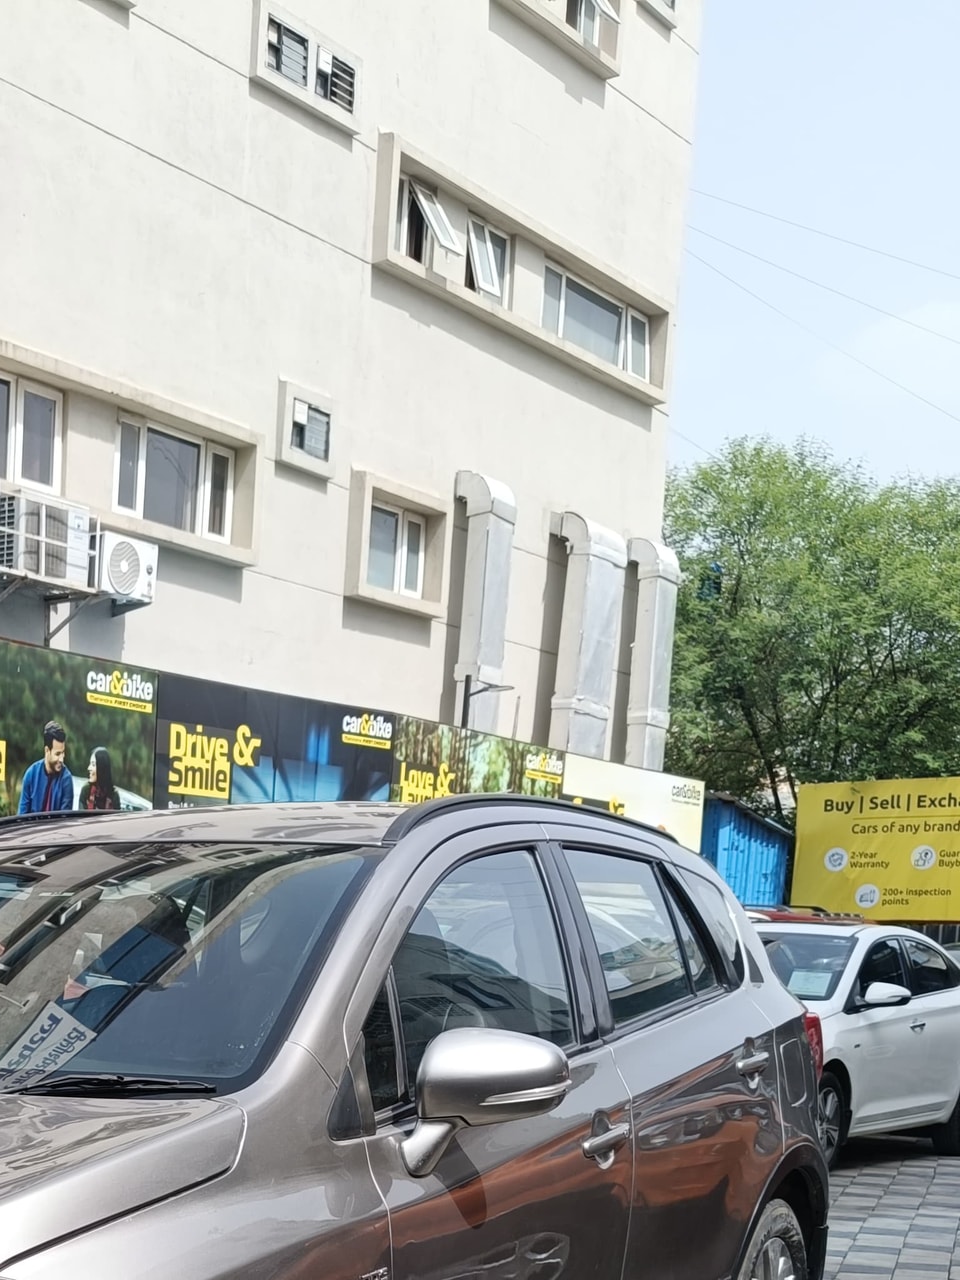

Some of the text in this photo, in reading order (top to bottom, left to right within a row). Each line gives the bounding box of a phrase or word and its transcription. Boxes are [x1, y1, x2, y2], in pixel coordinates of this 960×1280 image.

[86, 670, 153, 701] car&bike
[342, 713, 393, 739] car&bike
[169, 722, 262, 767] Drive &
[168, 756, 228, 793] Smile
[400, 762, 456, 794] Love &
[823, 798, 855, 815] Buy
[868, 794, 902, 811] Sell
[916, 792, 960, 809] Exch
[851, 823, 879, 835] Cars
[881, 820, 896, 834] of
[897, 823, 920, 835] any
[849, 860, 890, 869] Warranty
[850, 851, 878, 860] 2-Year
[881, 887, 952, 898] 200+ inspection
[881, 897, 910, 906] points
